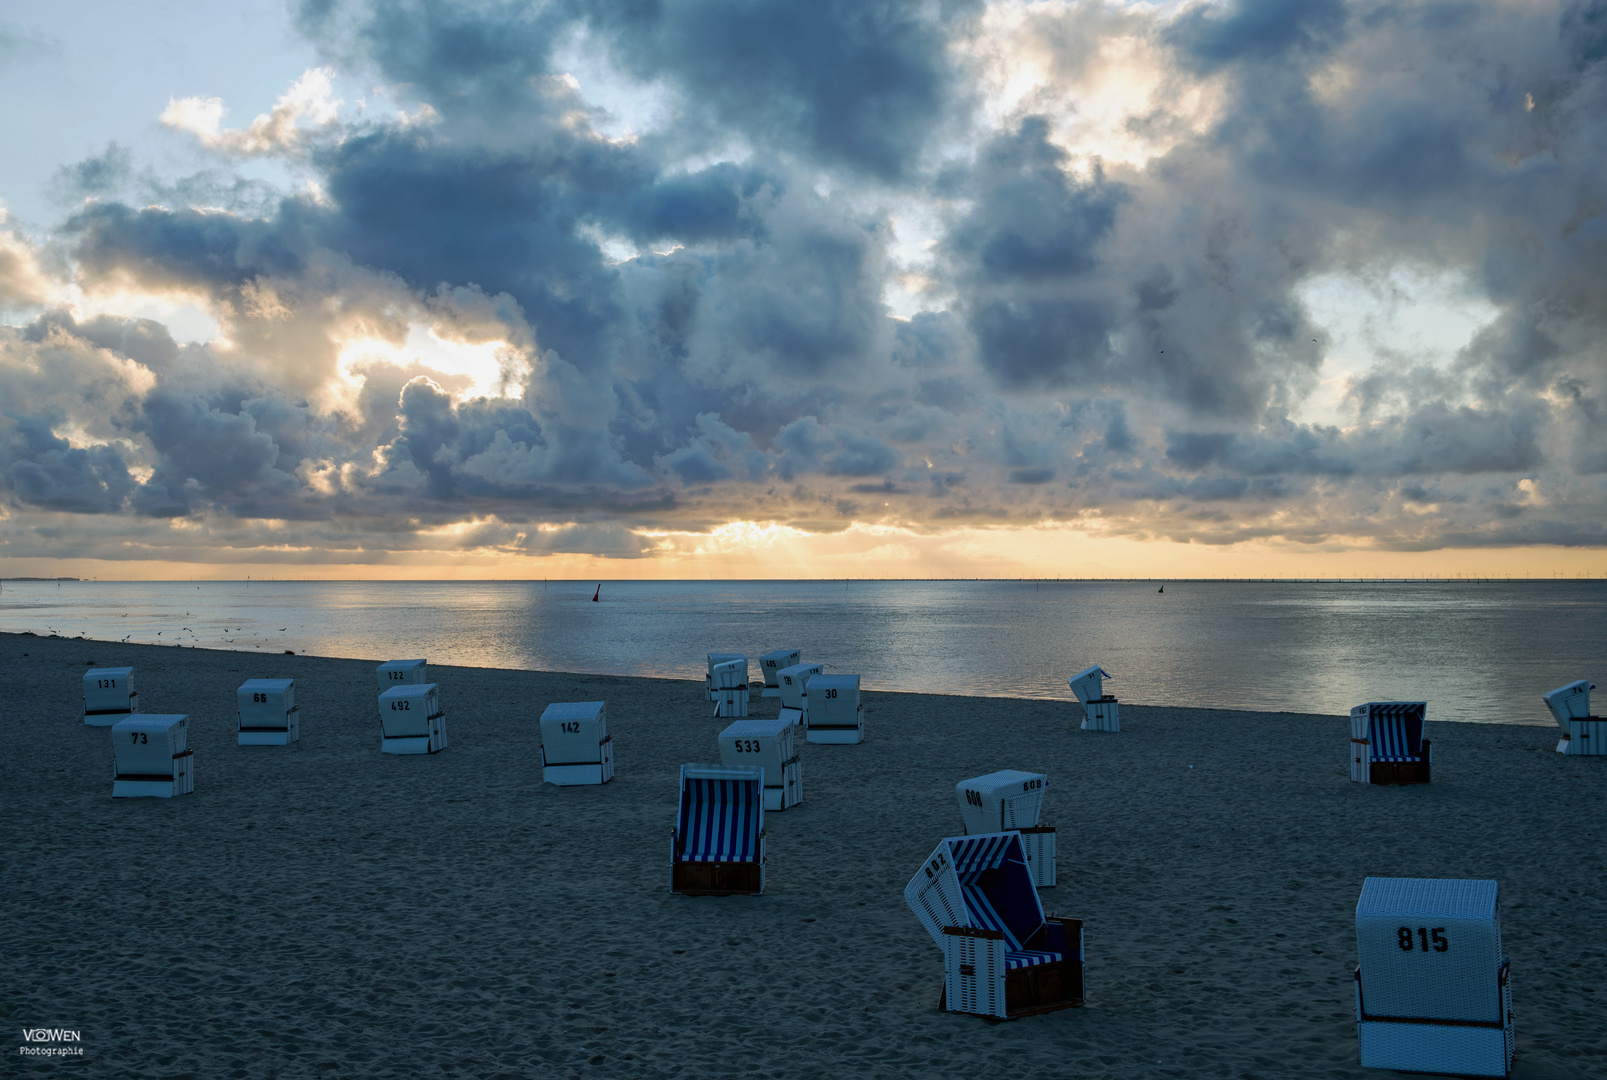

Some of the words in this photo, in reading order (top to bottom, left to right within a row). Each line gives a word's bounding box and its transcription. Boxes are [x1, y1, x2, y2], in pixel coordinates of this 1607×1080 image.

[388, 671, 404, 680] 122
[98, 680, 115, 688] 131
[254, 692, 266, 703] 66
[825, 688, 838, 699] 30
[391, 700, 410, 712] 492
[561, 722, 580, 734] 142
[132, 732, 148, 744] 73
[735, 740, 760, 753] 533
[1024, 780, 1042, 792] 608
[966, 788, 983, 808] 608
[925, 854, 946, 878] 802
[1398, 926, 1448, 952] 815
